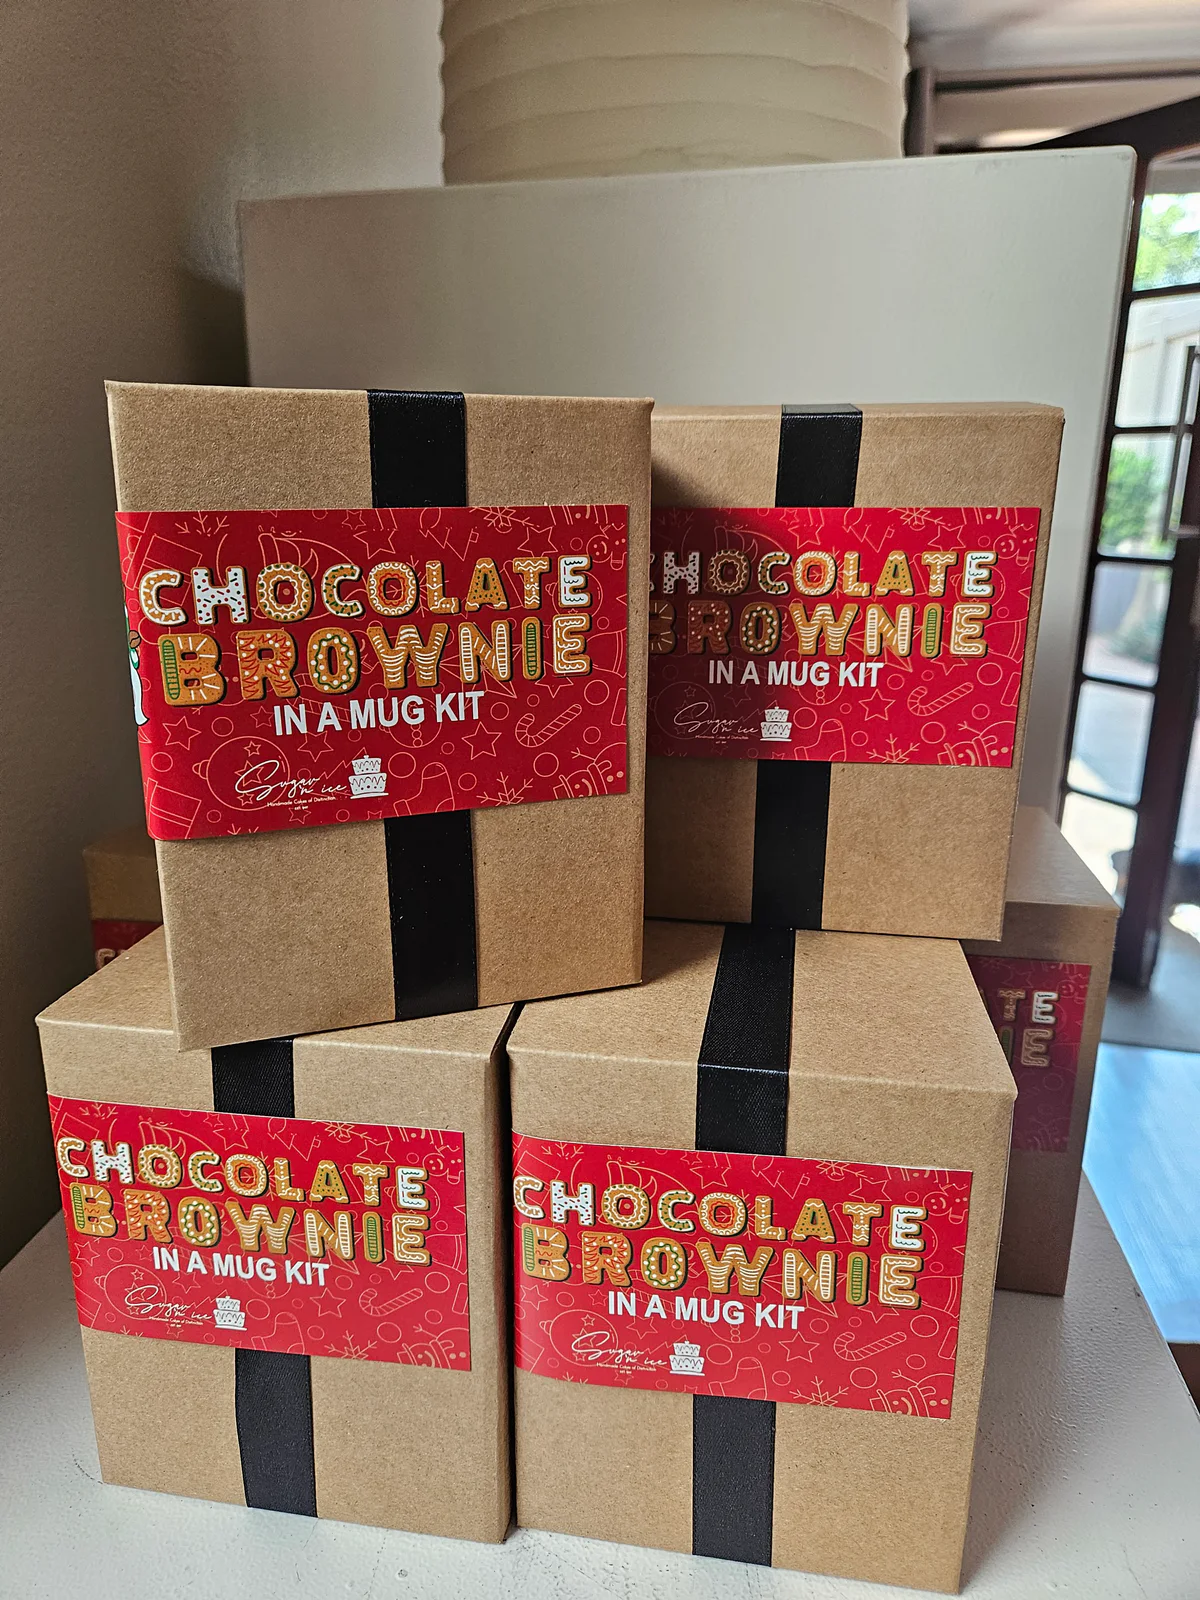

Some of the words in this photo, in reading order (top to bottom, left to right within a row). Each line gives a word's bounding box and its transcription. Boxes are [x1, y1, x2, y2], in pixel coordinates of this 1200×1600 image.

[139, 554, 593, 626] CHOCOLATE
[650, 549, 999, 598] HOCOLATE
[157, 613, 593, 707] BROWNIE
[708, 660, 734, 684] IN
[740, 661, 760, 685] A
[767, 661, 830, 687] MUG
[838, 661, 884, 687] KIT
[273, 703, 307, 736] IN
[317, 702, 343, 732] A
[349, 695, 425, 730] MUG
[435, 691, 485, 723] KIT
[673, 701, 739, 733] Sugar
[737, 725, 759, 734] ice
[234, 759, 321, 801] Sugar
[321, 783, 347, 793] ice
[56, 1137, 429, 1211] CHOCOLATE
[69, 1183, 432, 1267] BROWNIE
[513, 1174, 928, 1252] CHOCOLATE
[152, 1246, 180, 1272] IN
[187, 1250, 208, 1274] A
[212, 1253, 277, 1281] MUG
[284, 1260, 329, 1286] KIT
[521, 1222, 924, 1310] BROWNIE
[124, 1285, 191, 1317] Sugar
[191, 1311, 213, 1320] ice
[608, 1291, 637, 1316] IN
[644, 1294, 667, 1319] A
[675, 1296, 744, 1325] MUG
[755, 1302, 805, 1330] KIT
[571, 1330, 645, 1364] Sugar
[644, 1357, 668, 1365] ice
